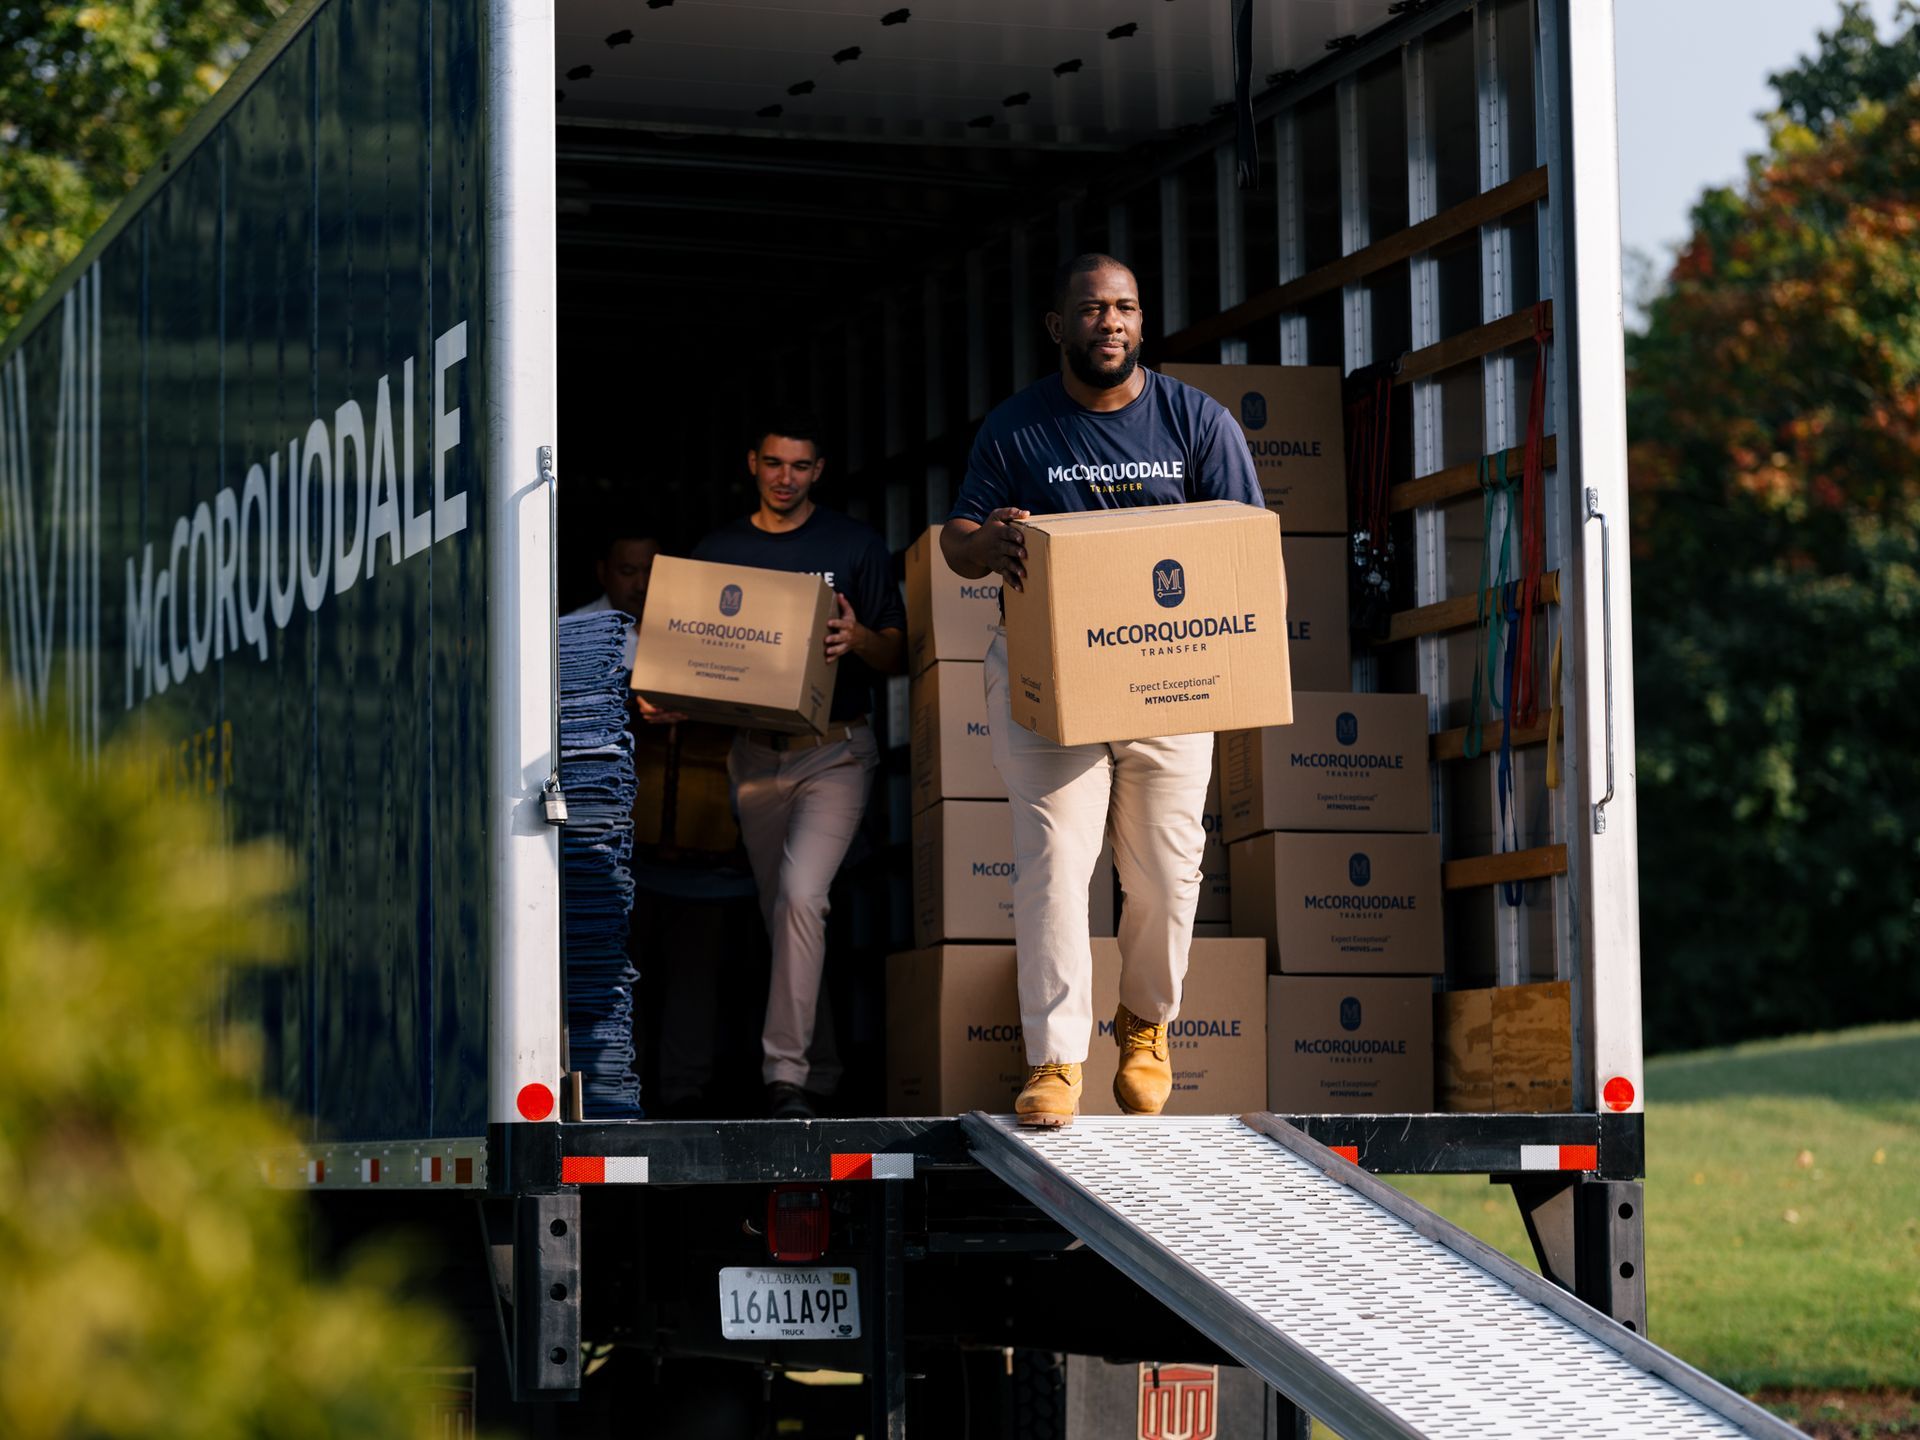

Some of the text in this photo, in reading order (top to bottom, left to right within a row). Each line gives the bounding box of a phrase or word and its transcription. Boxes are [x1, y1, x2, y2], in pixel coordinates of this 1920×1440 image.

[1048, 461, 1183, 484] McCORQUODALE
[1090, 482, 1143, 494] TRANSFER
[126, 319, 467, 711] McCORQUODALE
[668, 618, 783, 645] McCORQUODALE
[1087, 614, 1257, 648] McCORQUODALE
[701, 638, 746, 650] TRANSFER
[1141, 643, 1207, 657] TRANSFER
[1129, 682, 1161, 695] Expect
[1145, 692, 1210, 706] MTMOVES.com
[1290, 753, 1404, 769] McCORQUODALE
[1326, 770, 1370, 778] TRANSFER
[1304, 895, 1416, 911] McCORQUODALE
[1294, 1039, 1406, 1055] McCORQUODALE
[757, 1273, 821, 1285] ALABAMA
[730, 1289, 848, 1324] 16A1A9P
